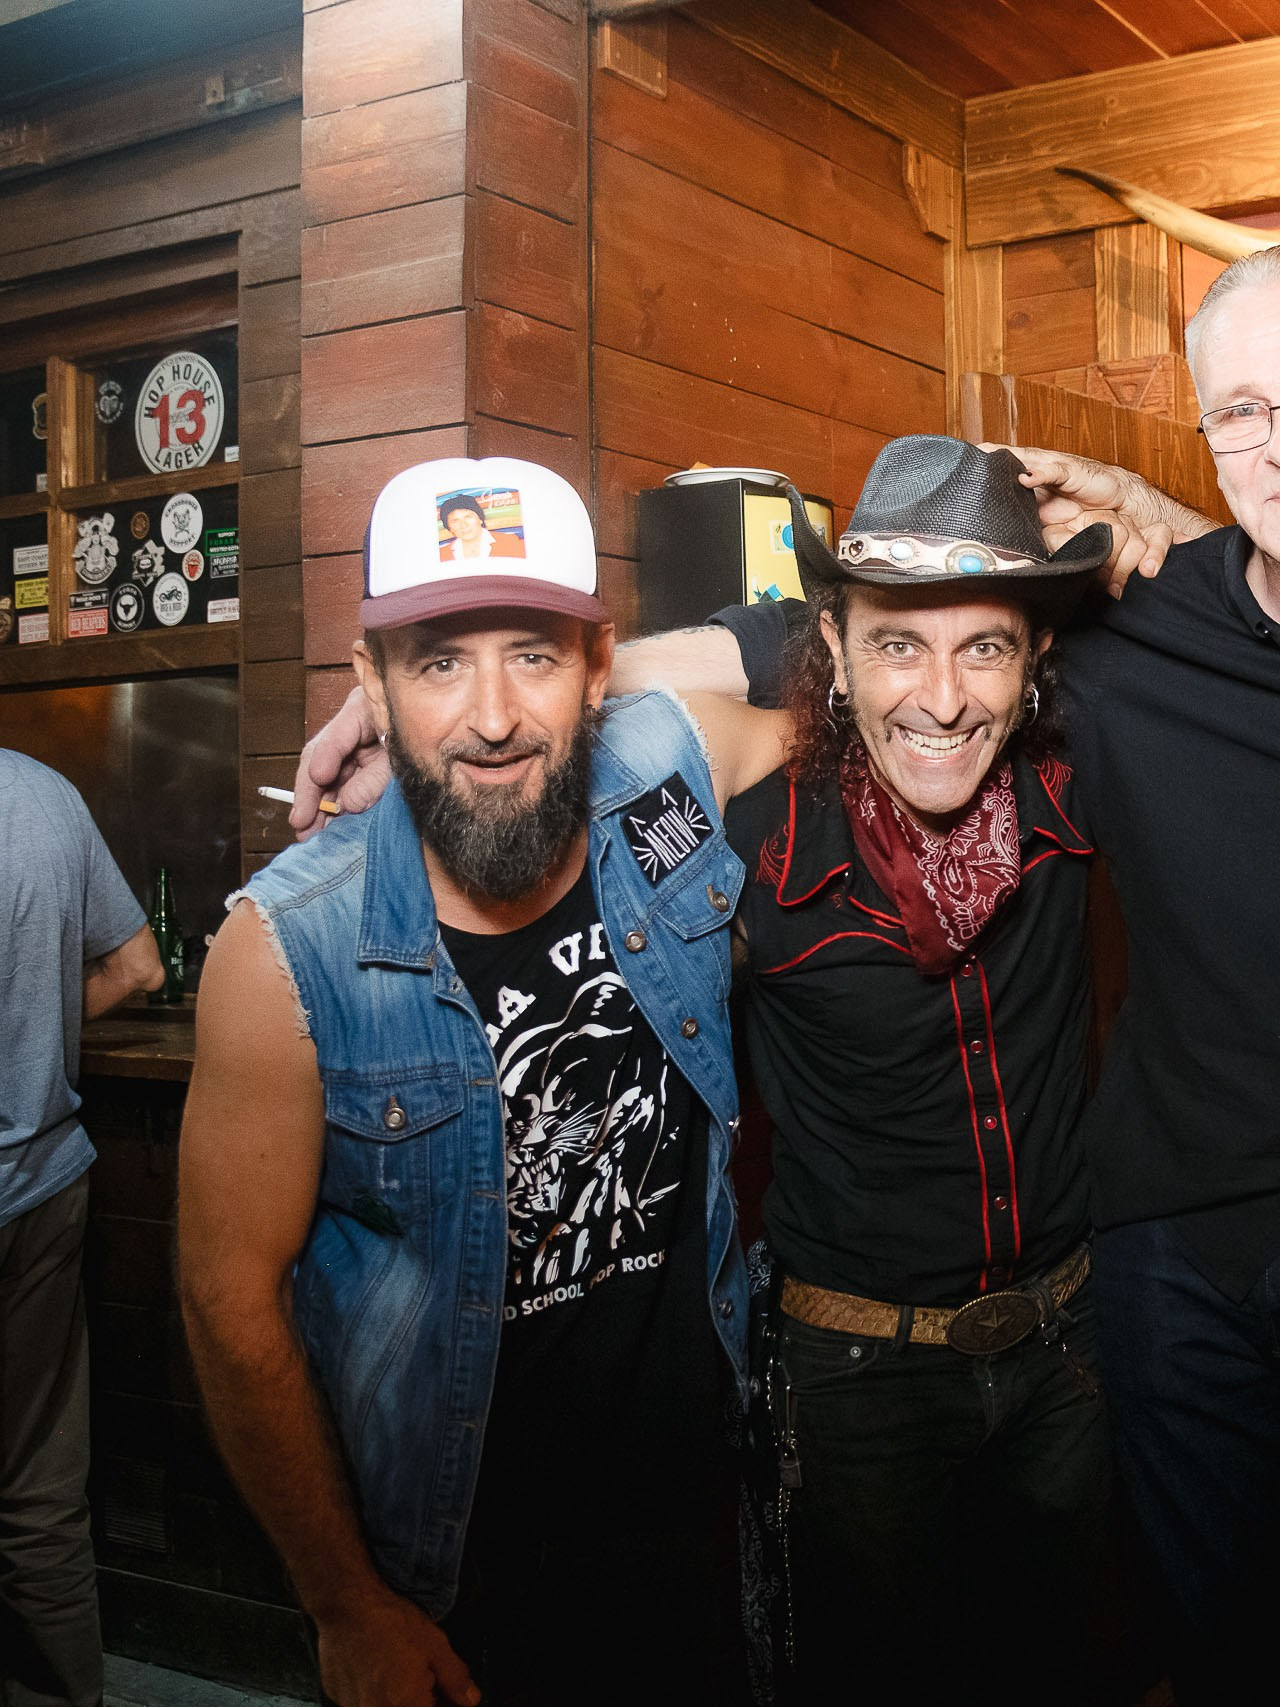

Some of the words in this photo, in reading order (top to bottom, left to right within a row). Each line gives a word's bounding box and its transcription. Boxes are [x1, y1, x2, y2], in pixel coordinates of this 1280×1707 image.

[144, 375, 165, 419] HOP
[171, 363, 216, 407] HOUSE
[152, 389, 206, 449] 13
[155, 441, 204, 470] LAGER
[643, 806, 700, 870] MEOW
[503, 1305, 518, 1321] D
[521, 1283, 585, 1316] SCHOOL
